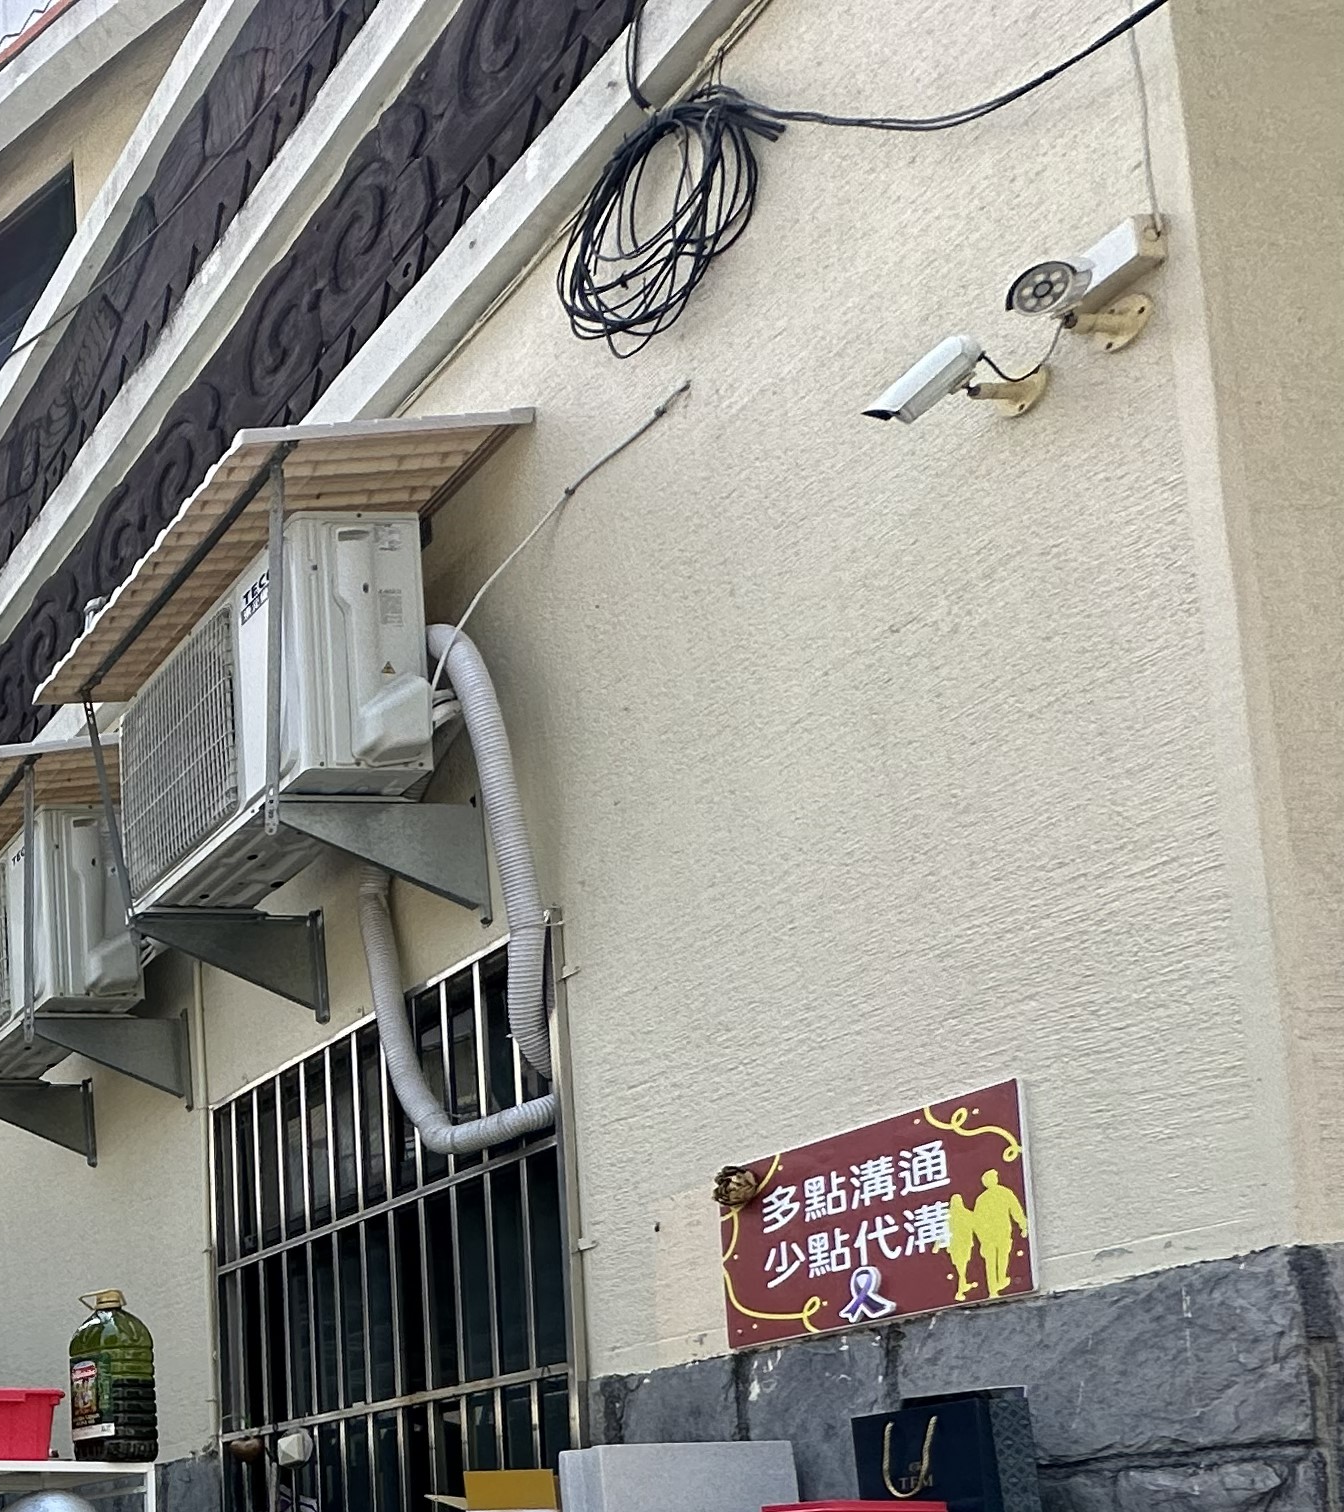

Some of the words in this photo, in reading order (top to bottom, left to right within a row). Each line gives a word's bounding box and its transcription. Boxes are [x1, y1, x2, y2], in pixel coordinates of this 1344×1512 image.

[243, 569, 269, 604] TEC
[762, 1140, 951, 1234] 多點溝通
[765, 1201, 953, 1289] 少點代溝
